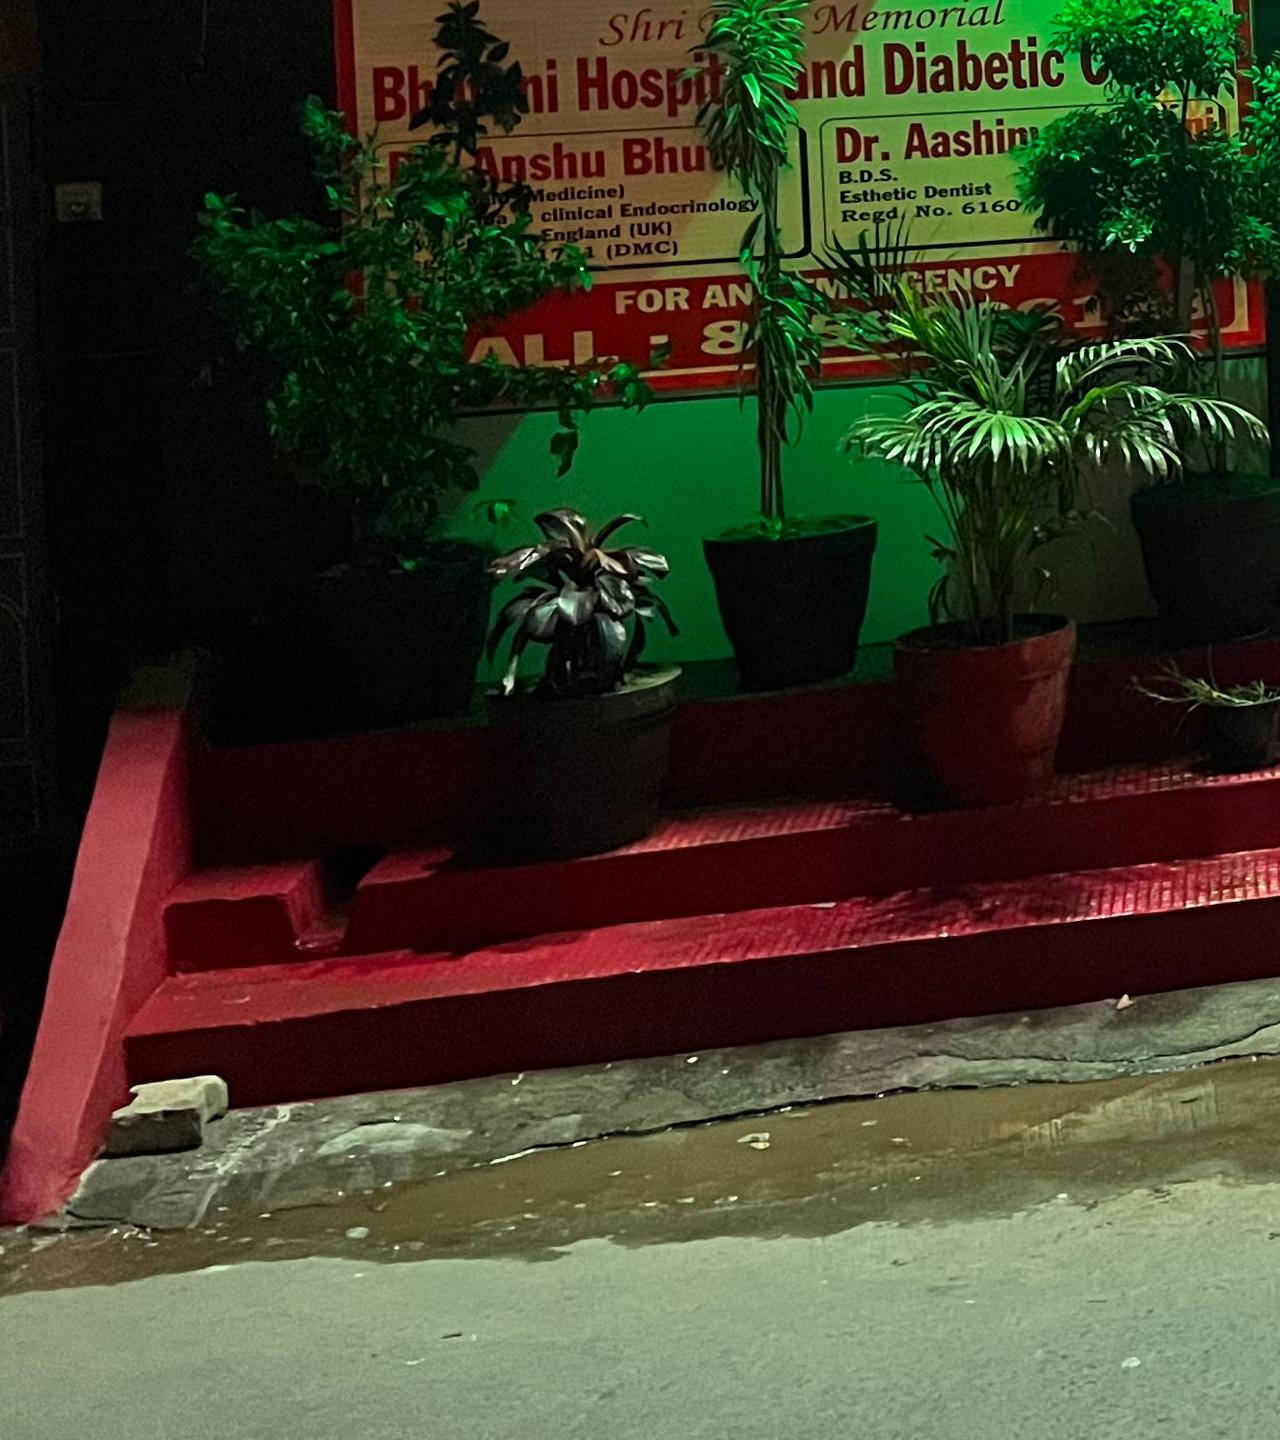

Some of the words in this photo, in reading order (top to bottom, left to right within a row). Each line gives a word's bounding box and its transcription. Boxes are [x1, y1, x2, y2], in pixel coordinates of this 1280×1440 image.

[599, 8, 689, 46] Shri
[882, 36, 1065, 96] Diabetic
[834, 126, 891, 164] Dr.
[838, 168, 899, 185] B.D.S.
[839, 186, 918, 205] Esthetic
[923, 182, 993, 200] Dentist
[540, 204, 613, 224] clinical
[619, 197, 760, 219] Endocrinology
[915, 204, 953, 219] No.
[541, 223, 622, 244] England
[629, 220, 673, 240] (UK)
[606, 240, 679, 261] (DMC)
[614, 286, 691, 315] FOR
